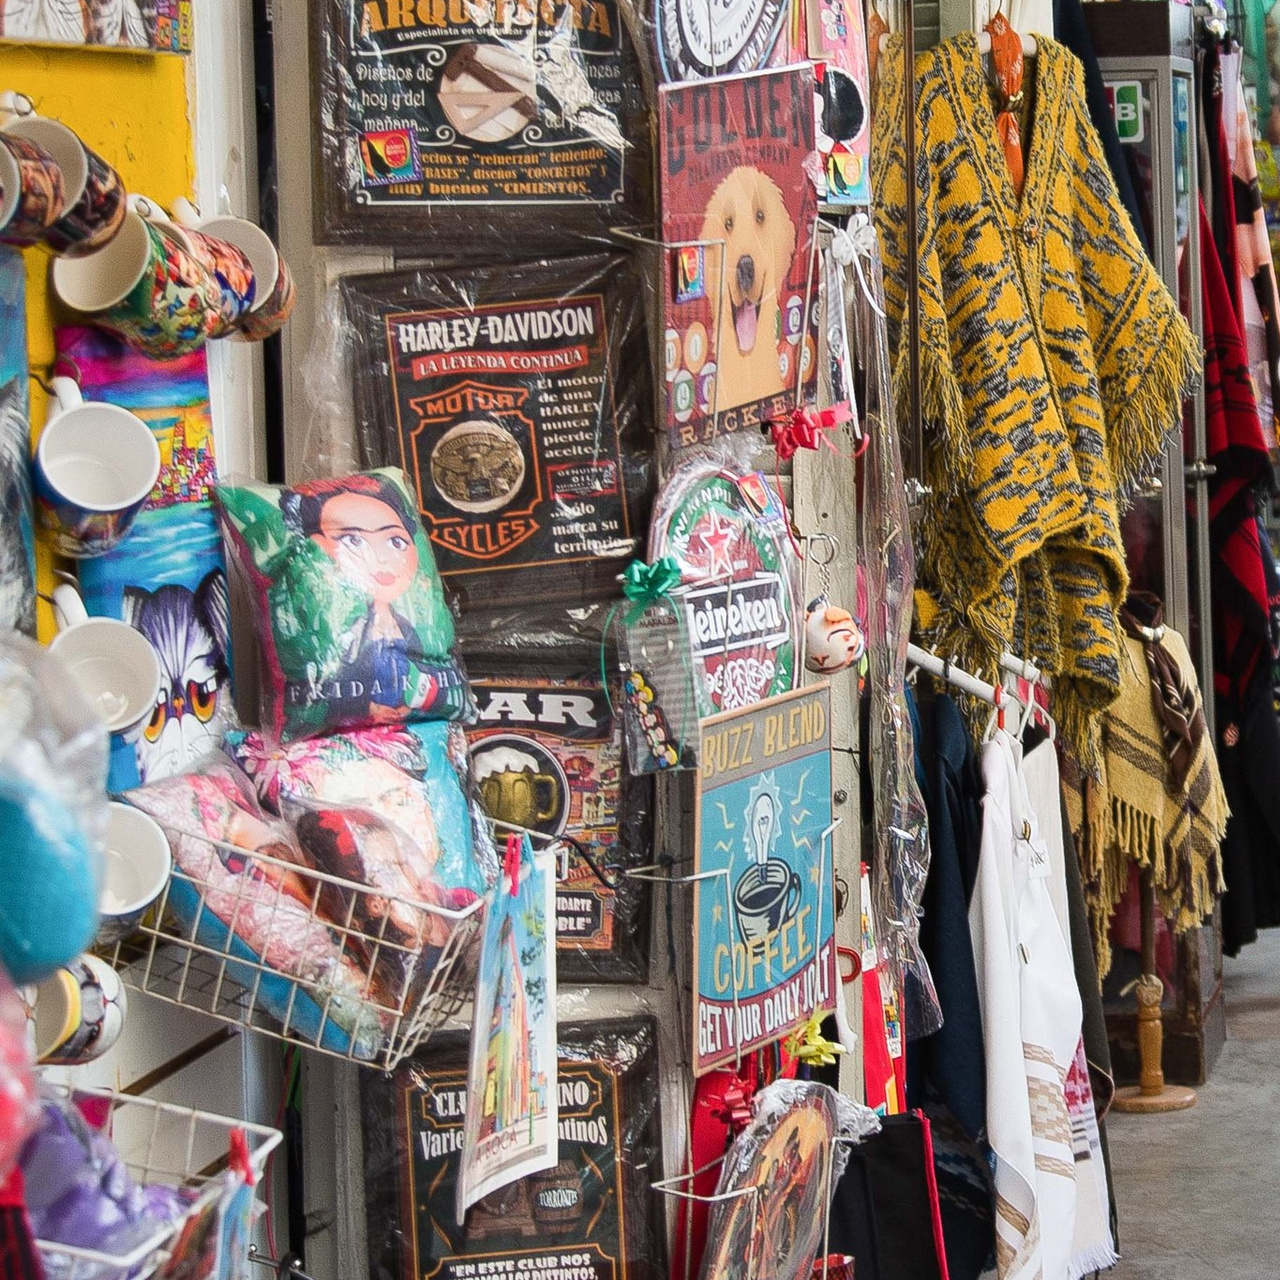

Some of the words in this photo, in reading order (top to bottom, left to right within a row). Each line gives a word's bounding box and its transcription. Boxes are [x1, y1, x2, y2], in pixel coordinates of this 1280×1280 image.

[416, 66, 435, 83] de
[361, 90, 388, 111] hoy
[391, 92, 405, 112] y
[405, 90, 426, 108] del
[666, 72, 813, 177] GOLDEN
[429, 182, 489, 195] buenos
[398, 306, 594, 354] HARLEY-DAVIDSON
[418, 360, 438, 377] LA
[441, 353, 508, 373] LEYENDA
[510, 349, 583, 370] CONTINUA
[426, 387, 515, 415] MOTOR
[538, 391, 558, 404] de
[563, 389, 593, 401] una
[541, 418, 590, 431] nunca
[680, 402, 760, 447] RACK
[543, 431, 595, 447] pierde
[550, 502, 596, 519] ...ólo
[439, 518, 527, 552] CYCLES
[552, 521, 598, 537] marca
[601, 519, 619, 531] su
[290, 674, 384, 703] FRIDA
[474, 692, 598, 728] AR
[703, 722, 754, 780] BUZZ
[764, 700, 826, 757] BLEND
[556, 916, 592, 932] BLE"
[714, 903, 812, 995] COFFEE
[699, 1001, 723, 1056] GET
[722, 992, 762, 1048] YOUR
[764, 975, 804, 1030] DAILY
[803, 946, 831, 1009] JOLT
[436, 1091, 468, 1118] CLU
[557, 1080, 590, 1107] INO
[420, 1126, 466, 1161] Varie
[451, 1264, 475, 1278] "EN
[478, 1260, 514, 1276] ESTE
[517, 1256, 558, 1273] CLUB
[561, 1252, 591, 1267] NOS
